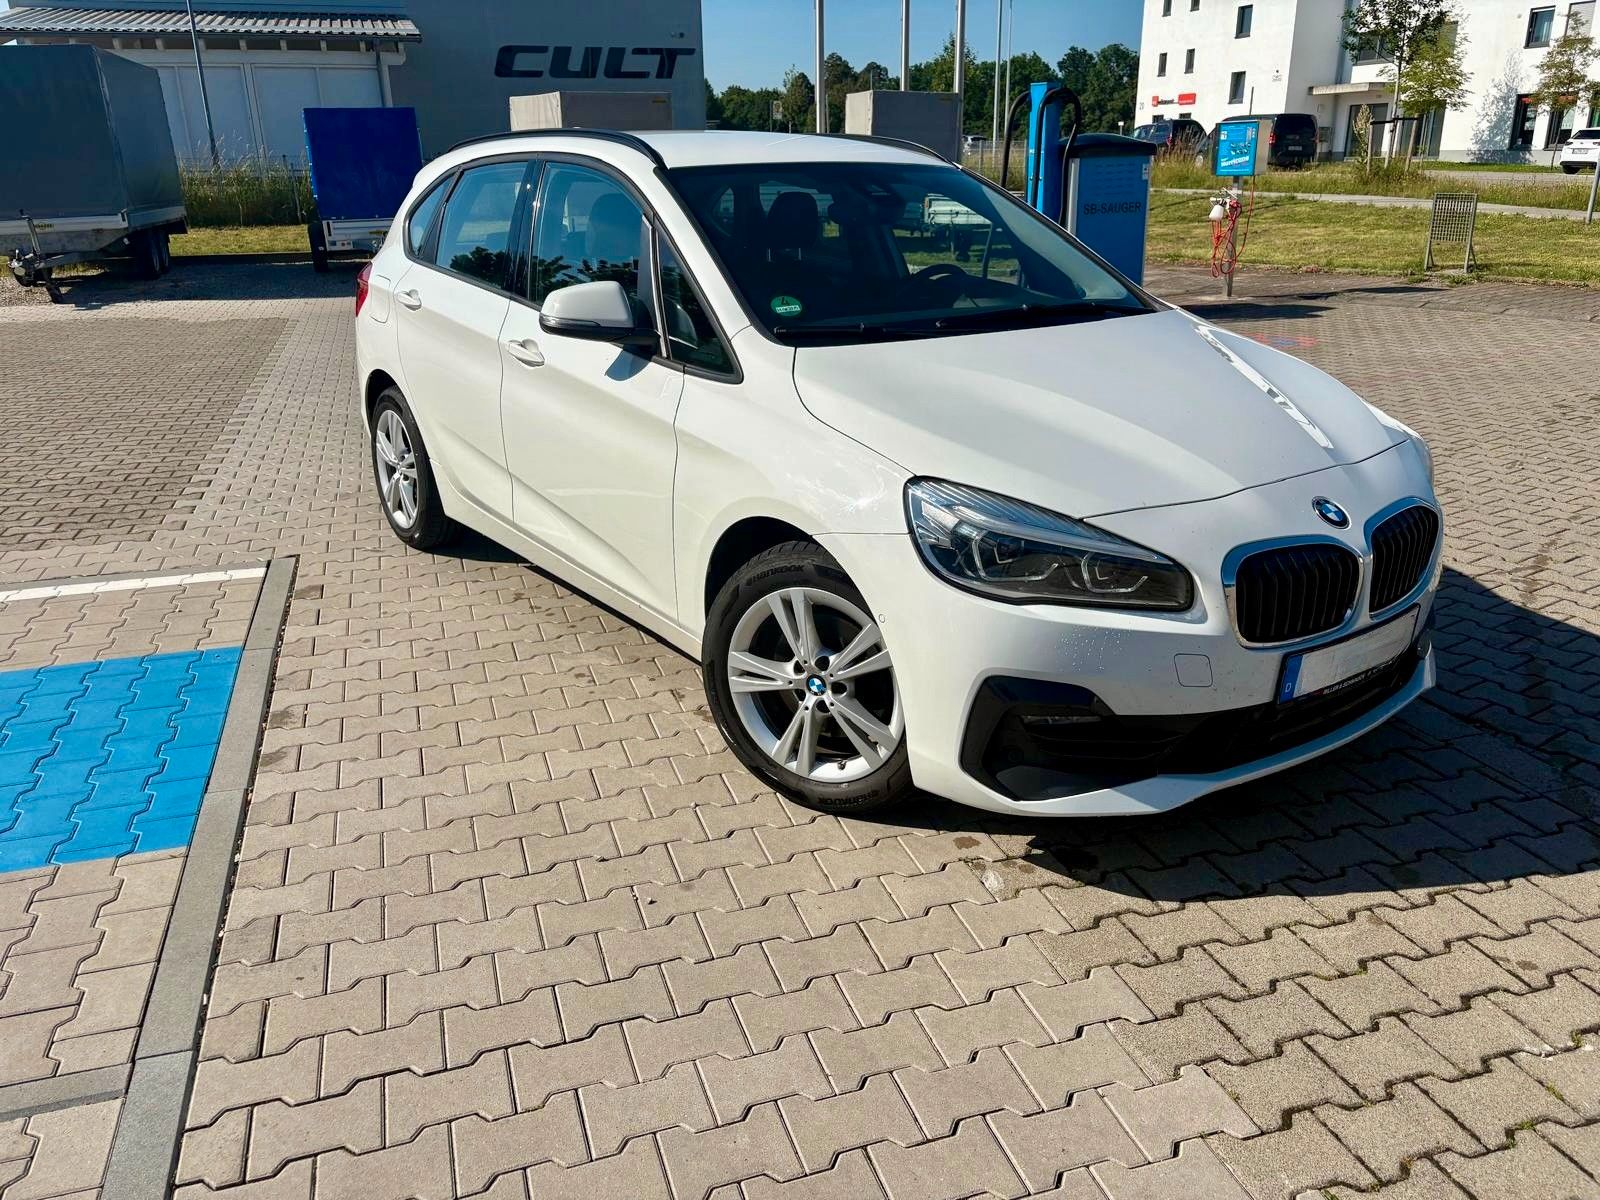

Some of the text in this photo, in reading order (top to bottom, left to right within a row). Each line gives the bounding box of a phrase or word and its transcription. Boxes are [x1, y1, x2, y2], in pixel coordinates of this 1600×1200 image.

[494, 45, 696, 79] CULT
[1083, 201, 1142, 215] SB-SAUGER
[781, 297, 790, 305] 4
[1285, 683, 1291, 692] D
